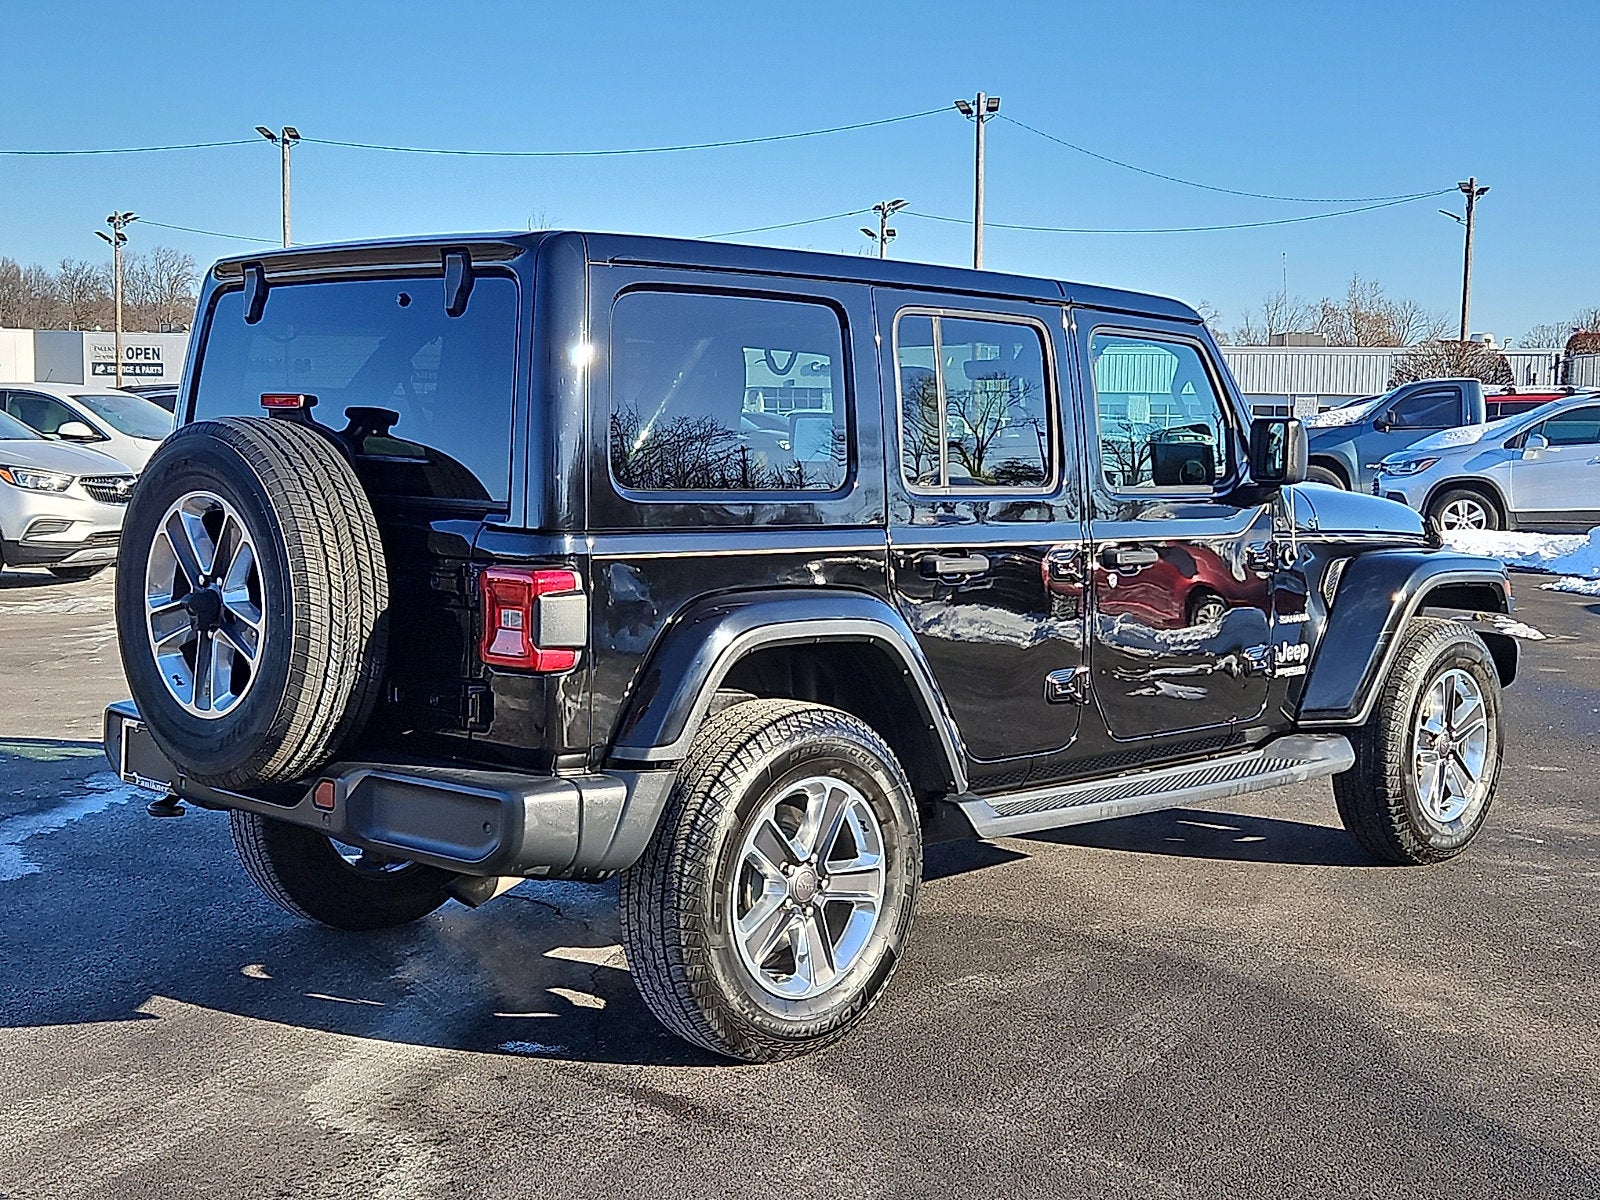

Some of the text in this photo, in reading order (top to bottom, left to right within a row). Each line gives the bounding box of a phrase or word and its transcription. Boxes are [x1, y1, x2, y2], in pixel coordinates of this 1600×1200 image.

[125, 346, 161, 361] OPEN
[106, 365, 134, 374] SEICE
[141, 366, 162, 374] PARTS
[1279, 640, 1310, 664] Jeep
